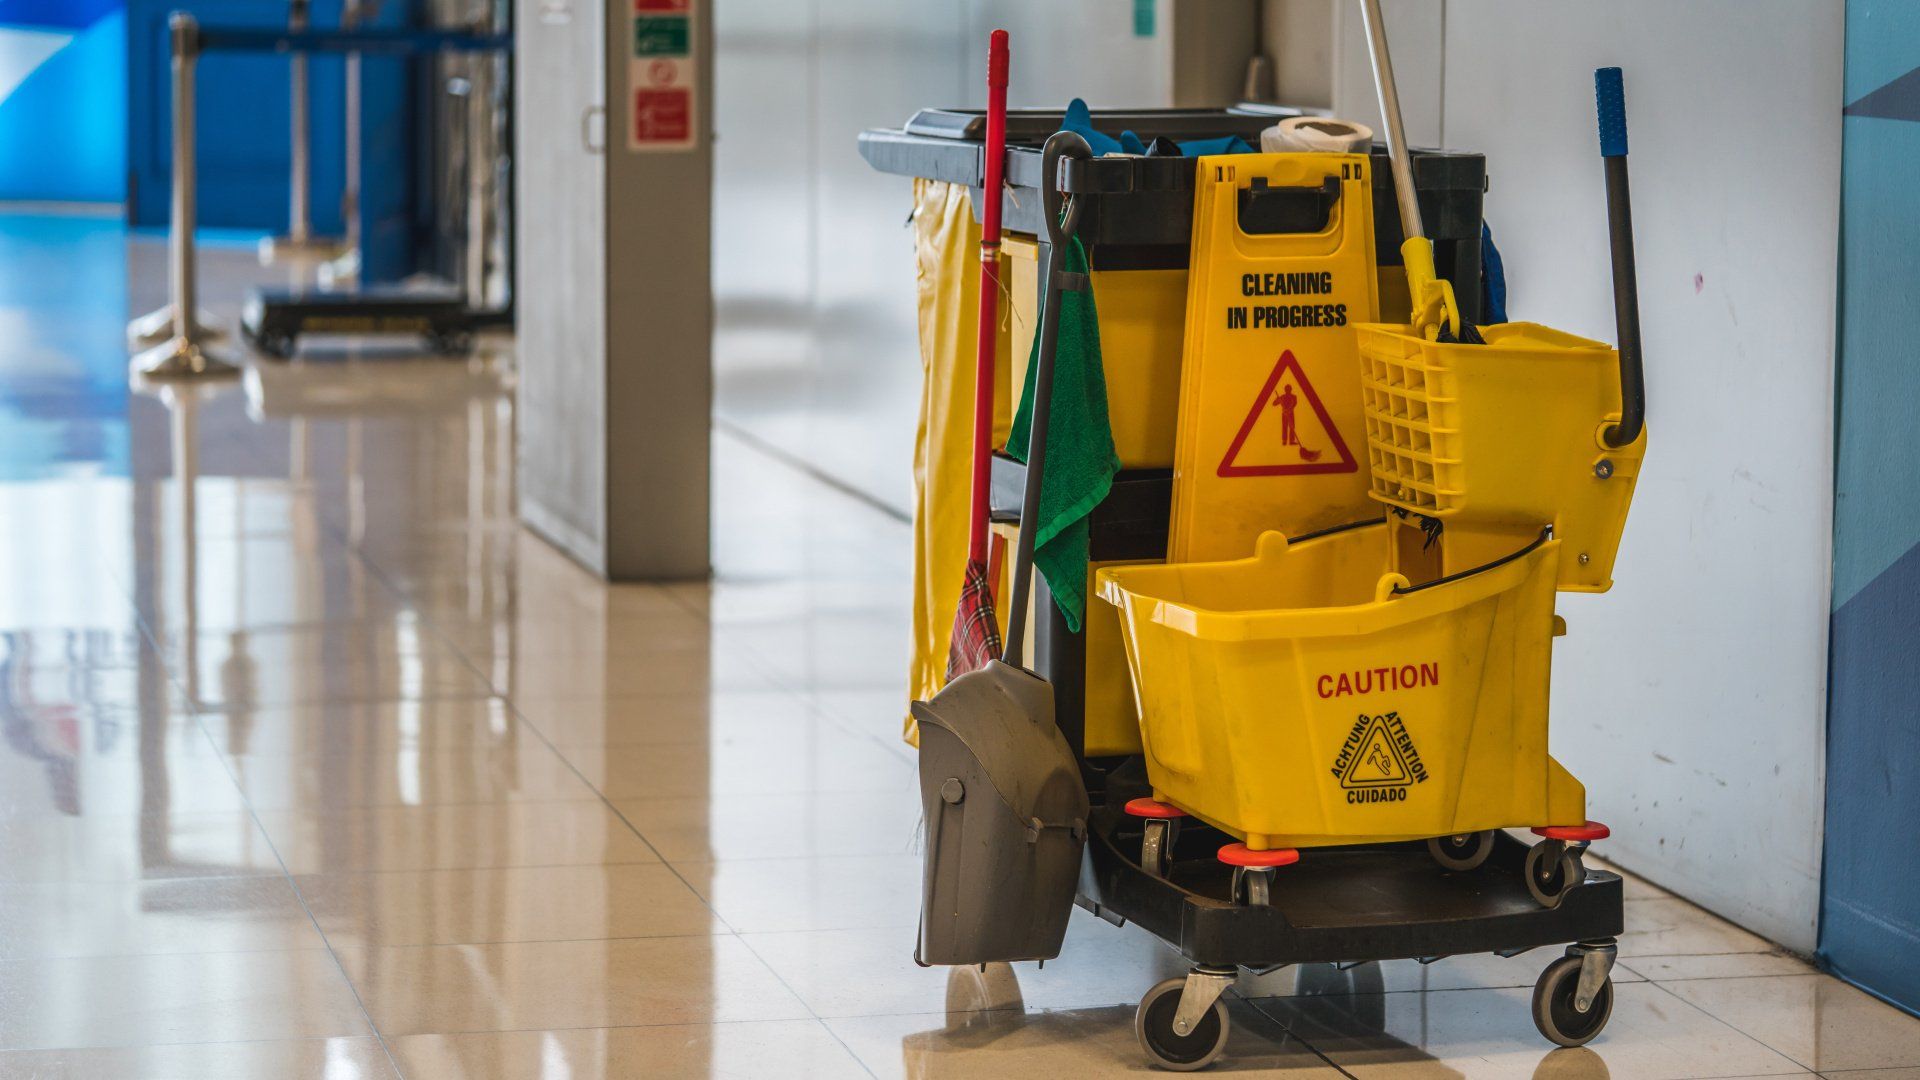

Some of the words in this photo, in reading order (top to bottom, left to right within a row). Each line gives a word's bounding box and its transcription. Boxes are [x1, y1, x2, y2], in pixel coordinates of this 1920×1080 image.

[1242, 271, 1332, 296] CLEANING
[1227, 307, 1247, 329] IN
[1253, 304, 1347, 329] PROGRESS
[1317, 662, 1439, 698] CAUTION
[1330, 714, 1370, 779] ACHTUNG
[1385, 711, 1429, 784] ATTENTION
[1347, 787, 1407, 804] CUIDADO
